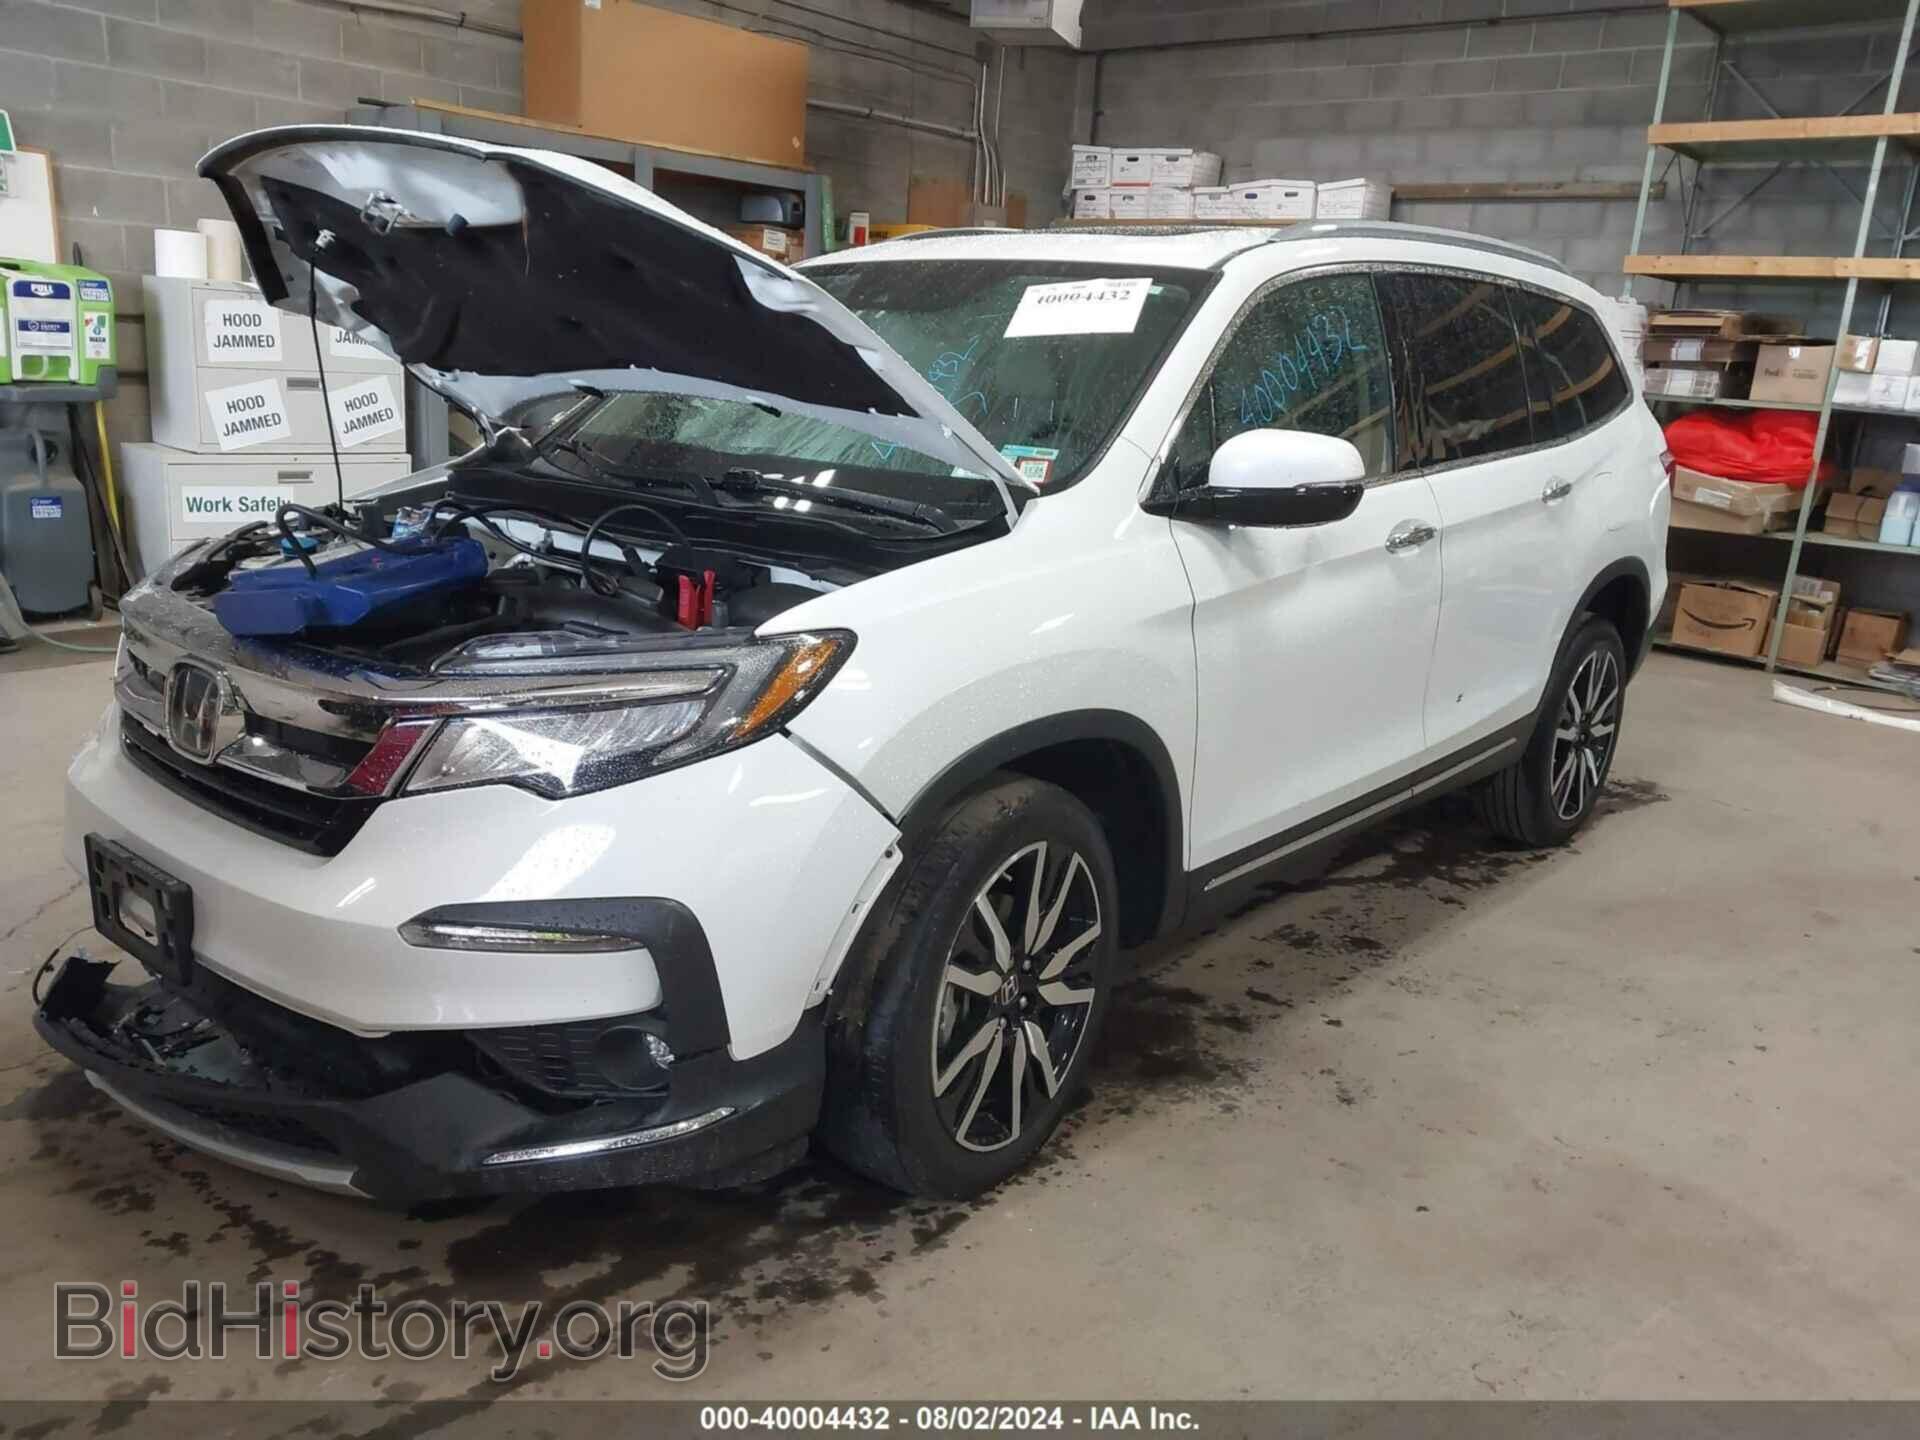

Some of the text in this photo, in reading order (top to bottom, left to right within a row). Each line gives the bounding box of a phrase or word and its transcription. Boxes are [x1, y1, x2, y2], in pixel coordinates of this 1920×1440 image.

[31, 283, 54, 295] PULL
[223, 313, 262, 327] HOOD
[213, 334, 275, 348] JAMMED
[226, 394, 265, 414] HOOD
[344, 391, 378, 412] HOOD
[223, 412, 282, 437] JAMMED
[343, 407, 394, 434] JAMMED
[185, 496, 291, 513] Work Safel
